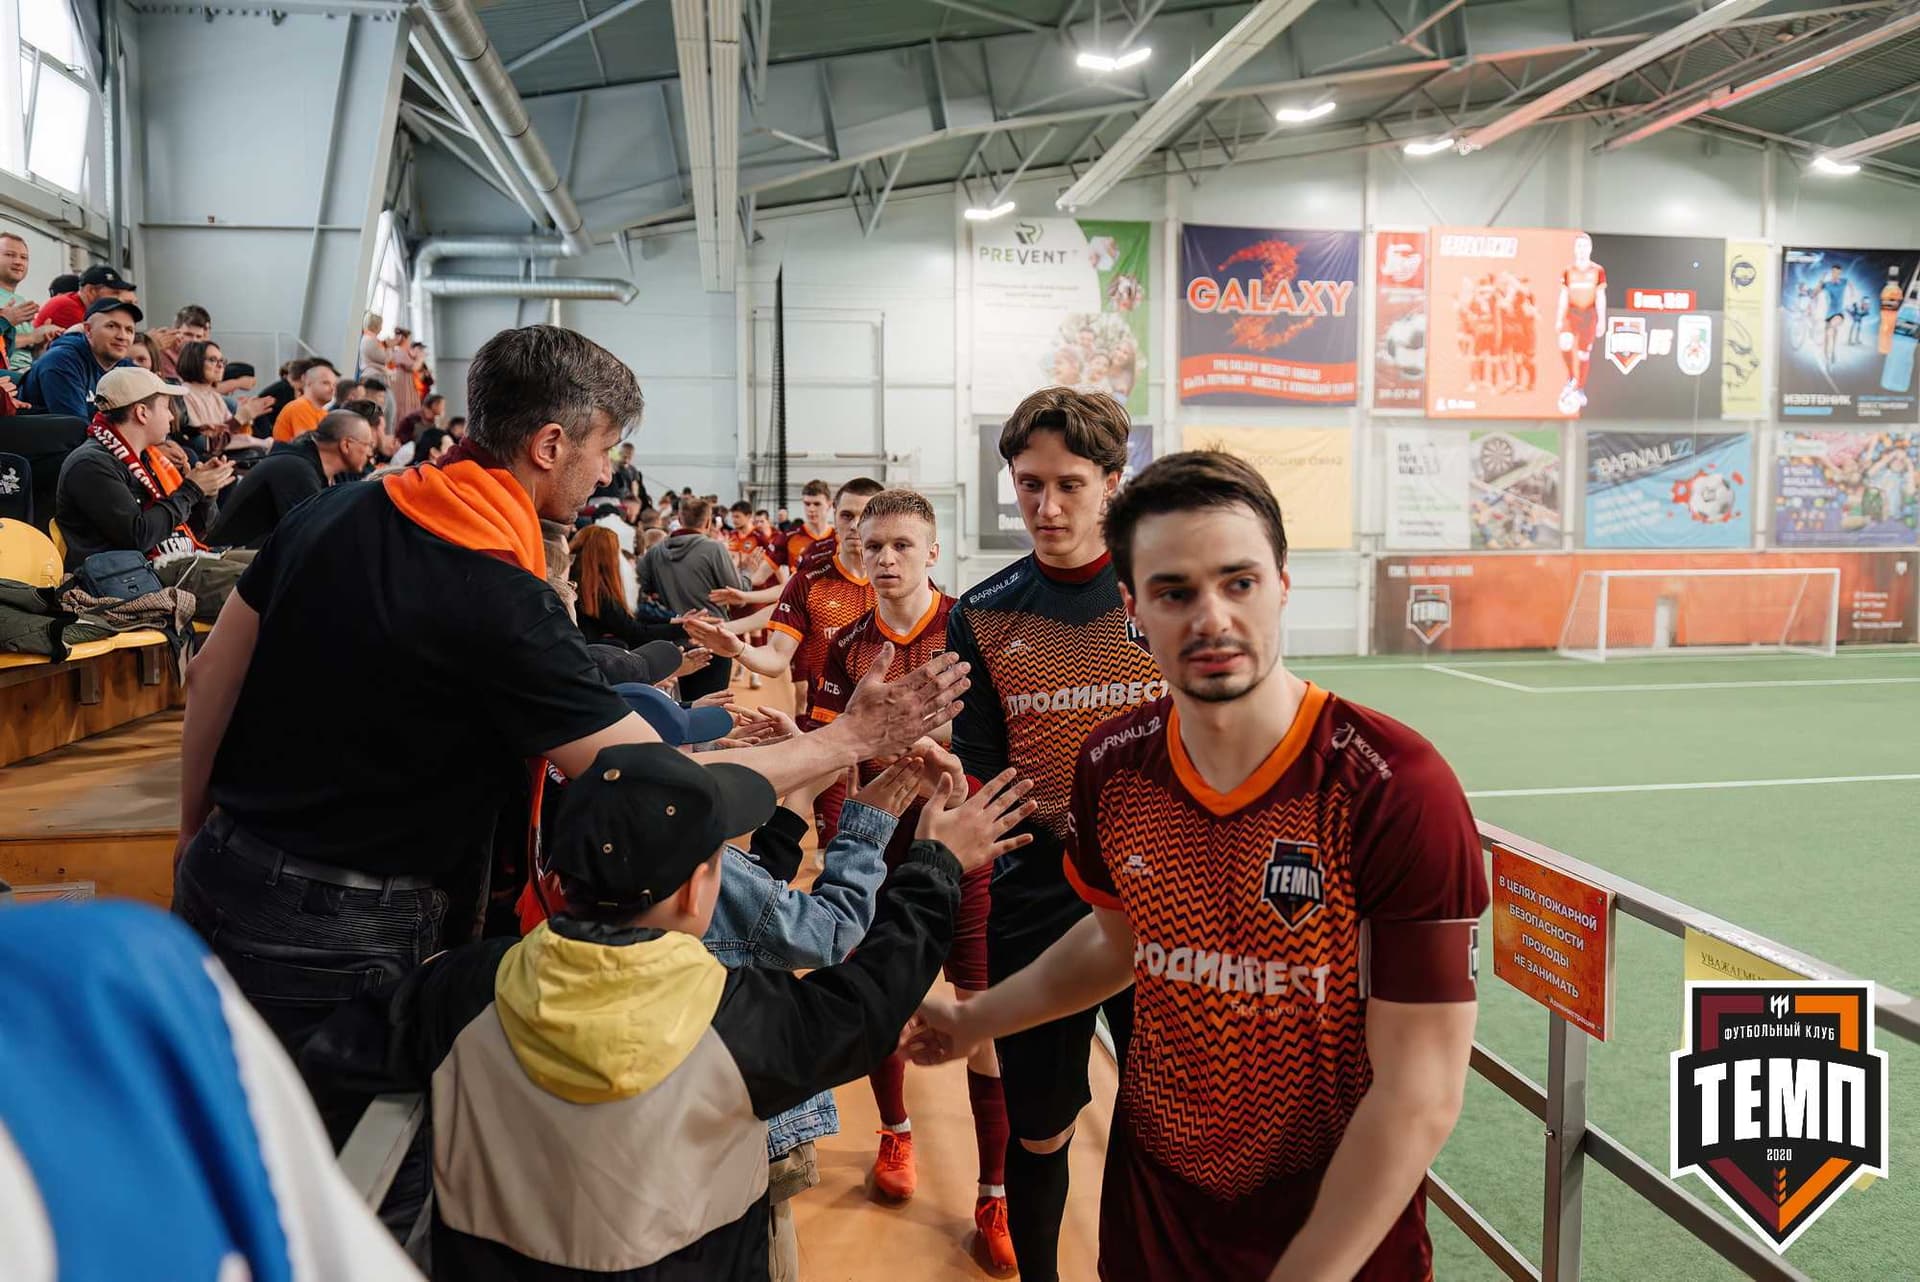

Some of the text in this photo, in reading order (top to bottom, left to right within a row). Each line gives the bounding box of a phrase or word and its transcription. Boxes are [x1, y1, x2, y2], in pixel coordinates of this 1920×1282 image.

[980, 247, 1067, 265] PREVENT
[1187, 277, 1354, 317] GALAXY
[969, 572, 1020, 603] BARNAUL22
[1090, 716, 1162, 763] BARNAUL22
[1270, 865, 1320, 900] ТЕМП
[1499, 876, 1598, 931] В ЦЕЛЯХ ПОЖАРНОЙ
[1509, 903, 1584, 950] БЕЗОПАСНОСТИ
[1522, 934, 1569, 968] ПРОХОДЫ
[1701, 951, 1765, 980] УВАЖАЕМ
[1134, 940, 1330, 1004] РОДИНВЕСТ
[1514, 952, 1579, 999] НЕ ЗАНИМАТЬ
